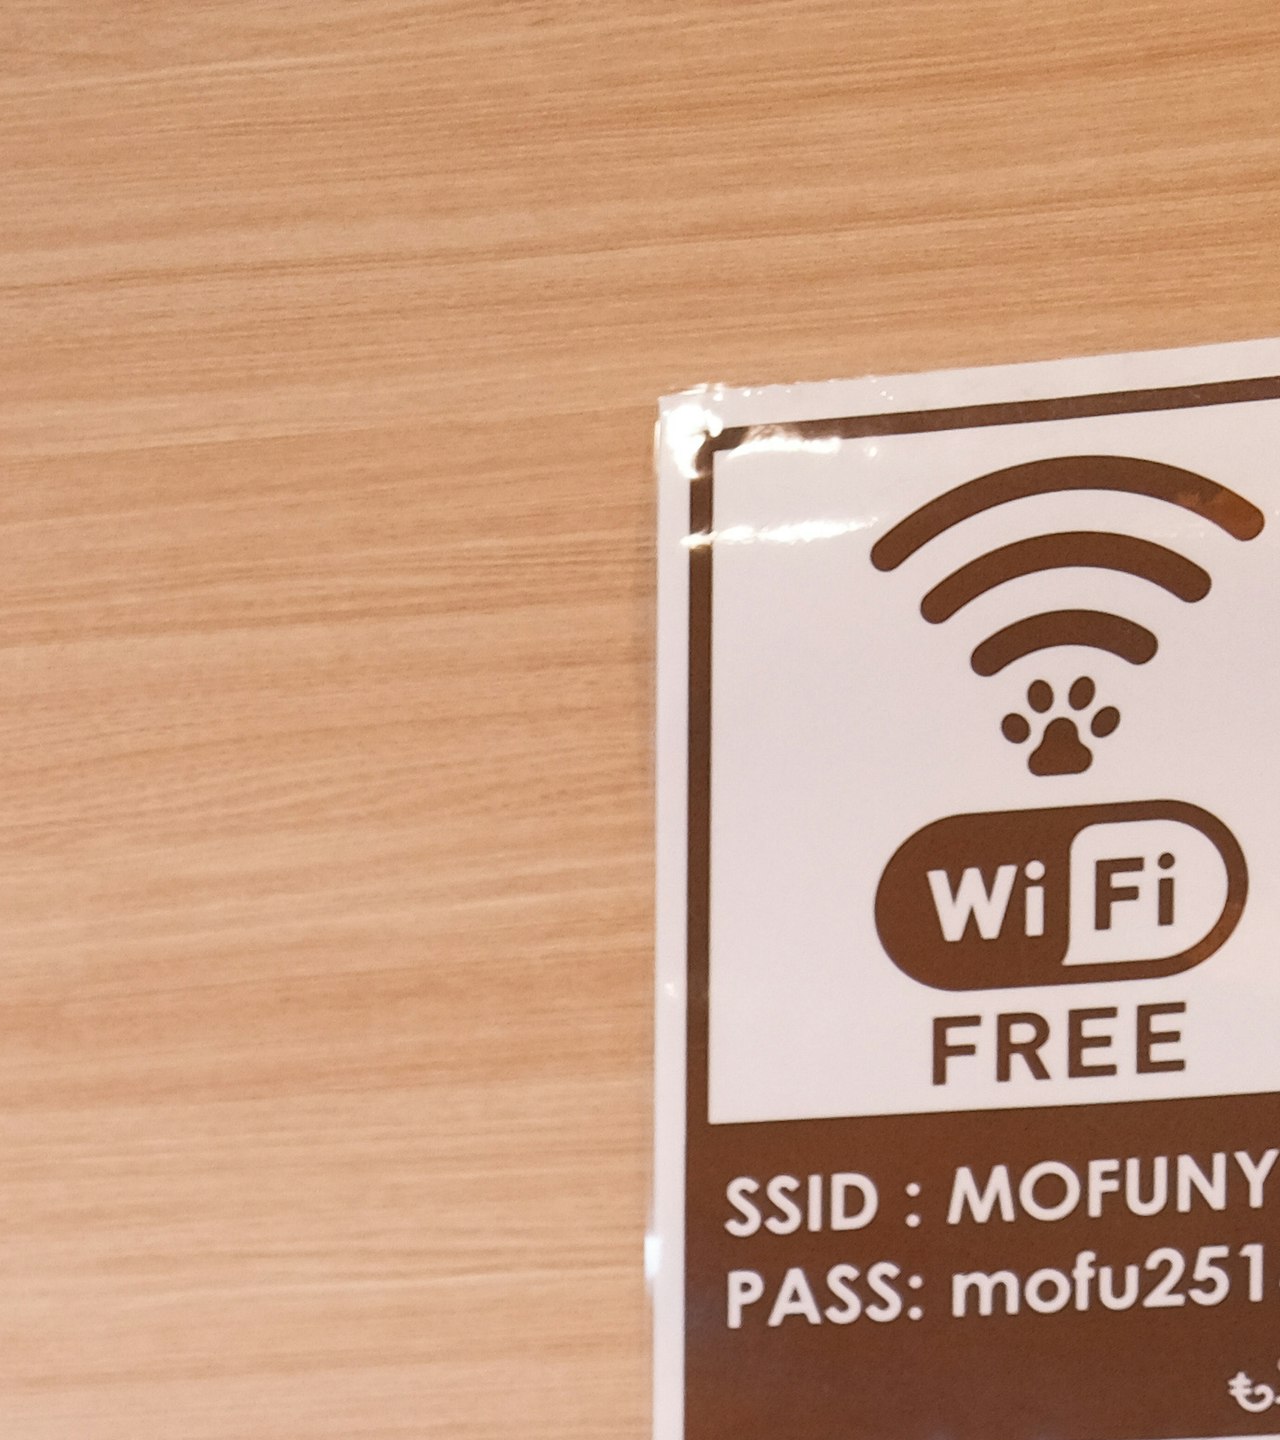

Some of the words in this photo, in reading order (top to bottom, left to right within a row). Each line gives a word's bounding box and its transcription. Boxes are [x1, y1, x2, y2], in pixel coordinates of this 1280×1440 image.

[931, 1001, 1188, 1087] FREE
[724, 1171, 879, 1237] SSID
[947, 1148, 1280, 1226] MOFUNY
[727, 1260, 924, 1330] PASS:
[952, 1242, 1280, 1319] mofu251
